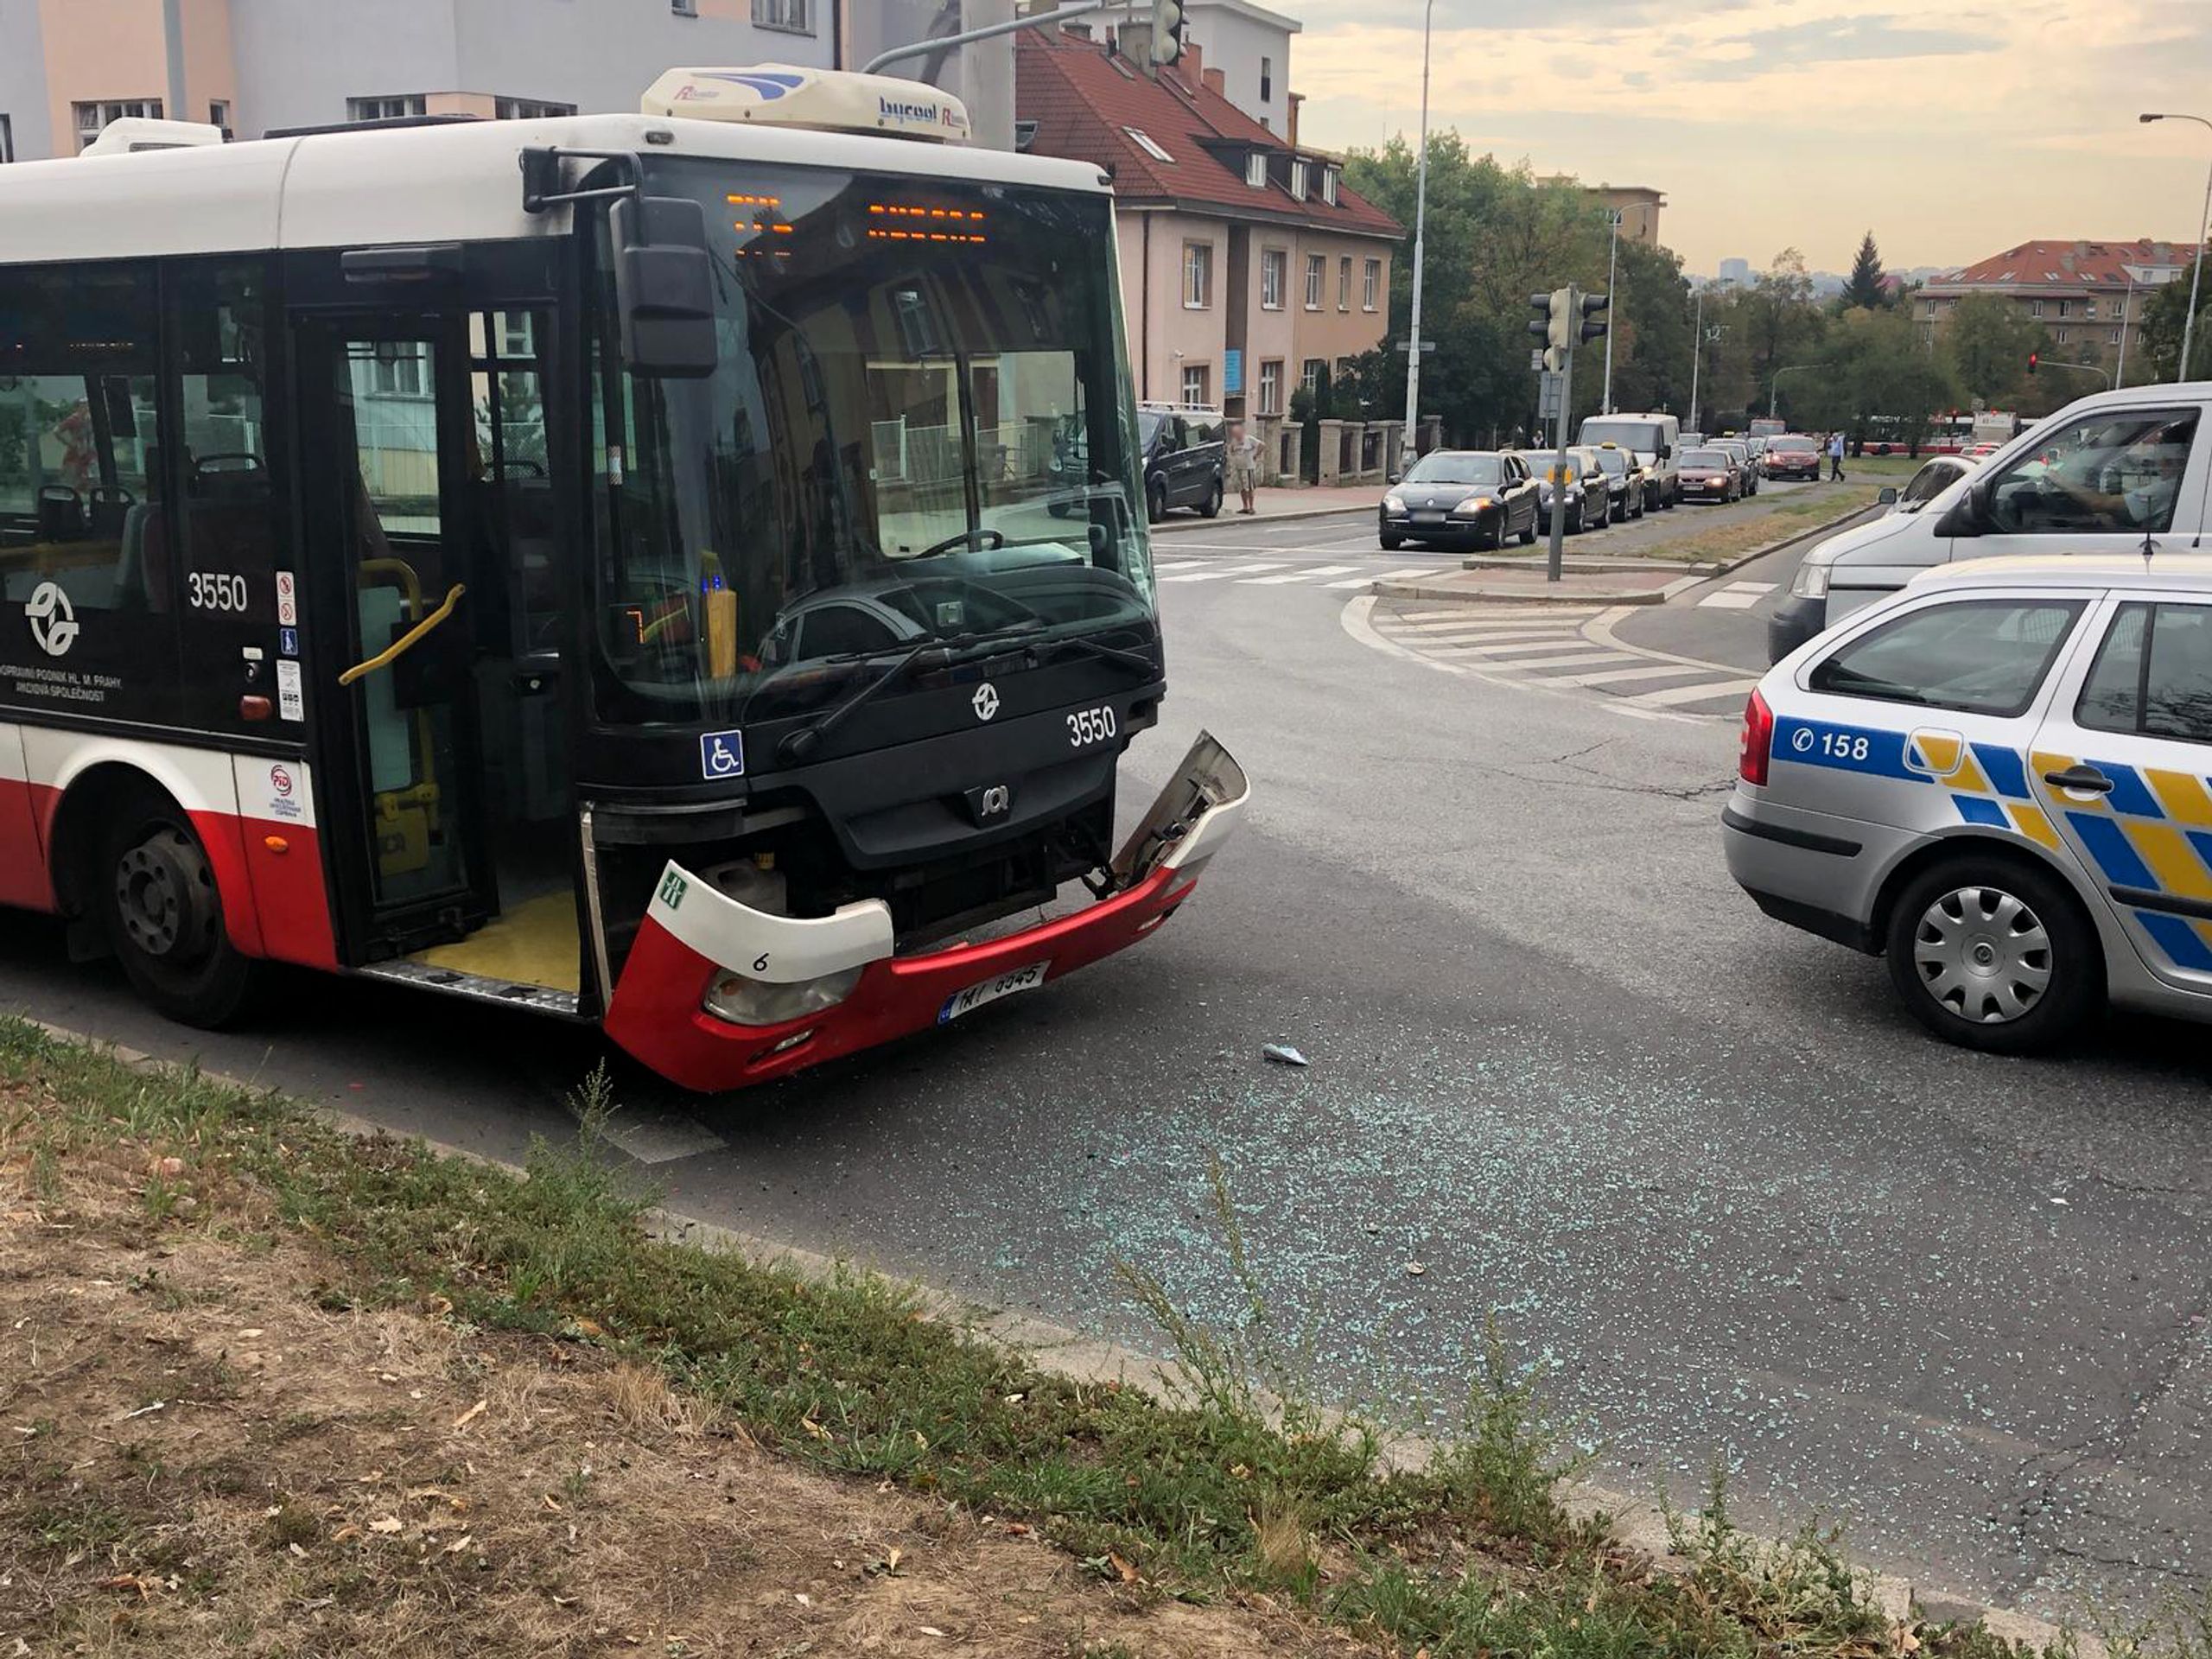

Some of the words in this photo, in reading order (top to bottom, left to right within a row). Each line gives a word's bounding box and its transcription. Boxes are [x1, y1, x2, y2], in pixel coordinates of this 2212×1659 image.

[880, 96, 937, 124] bycool
[189, 572, 247, 612] 3550
[1066, 705, 1116, 747] 3550
[1822, 733, 1869, 760] 158
[753, 952, 769, 972] 6
